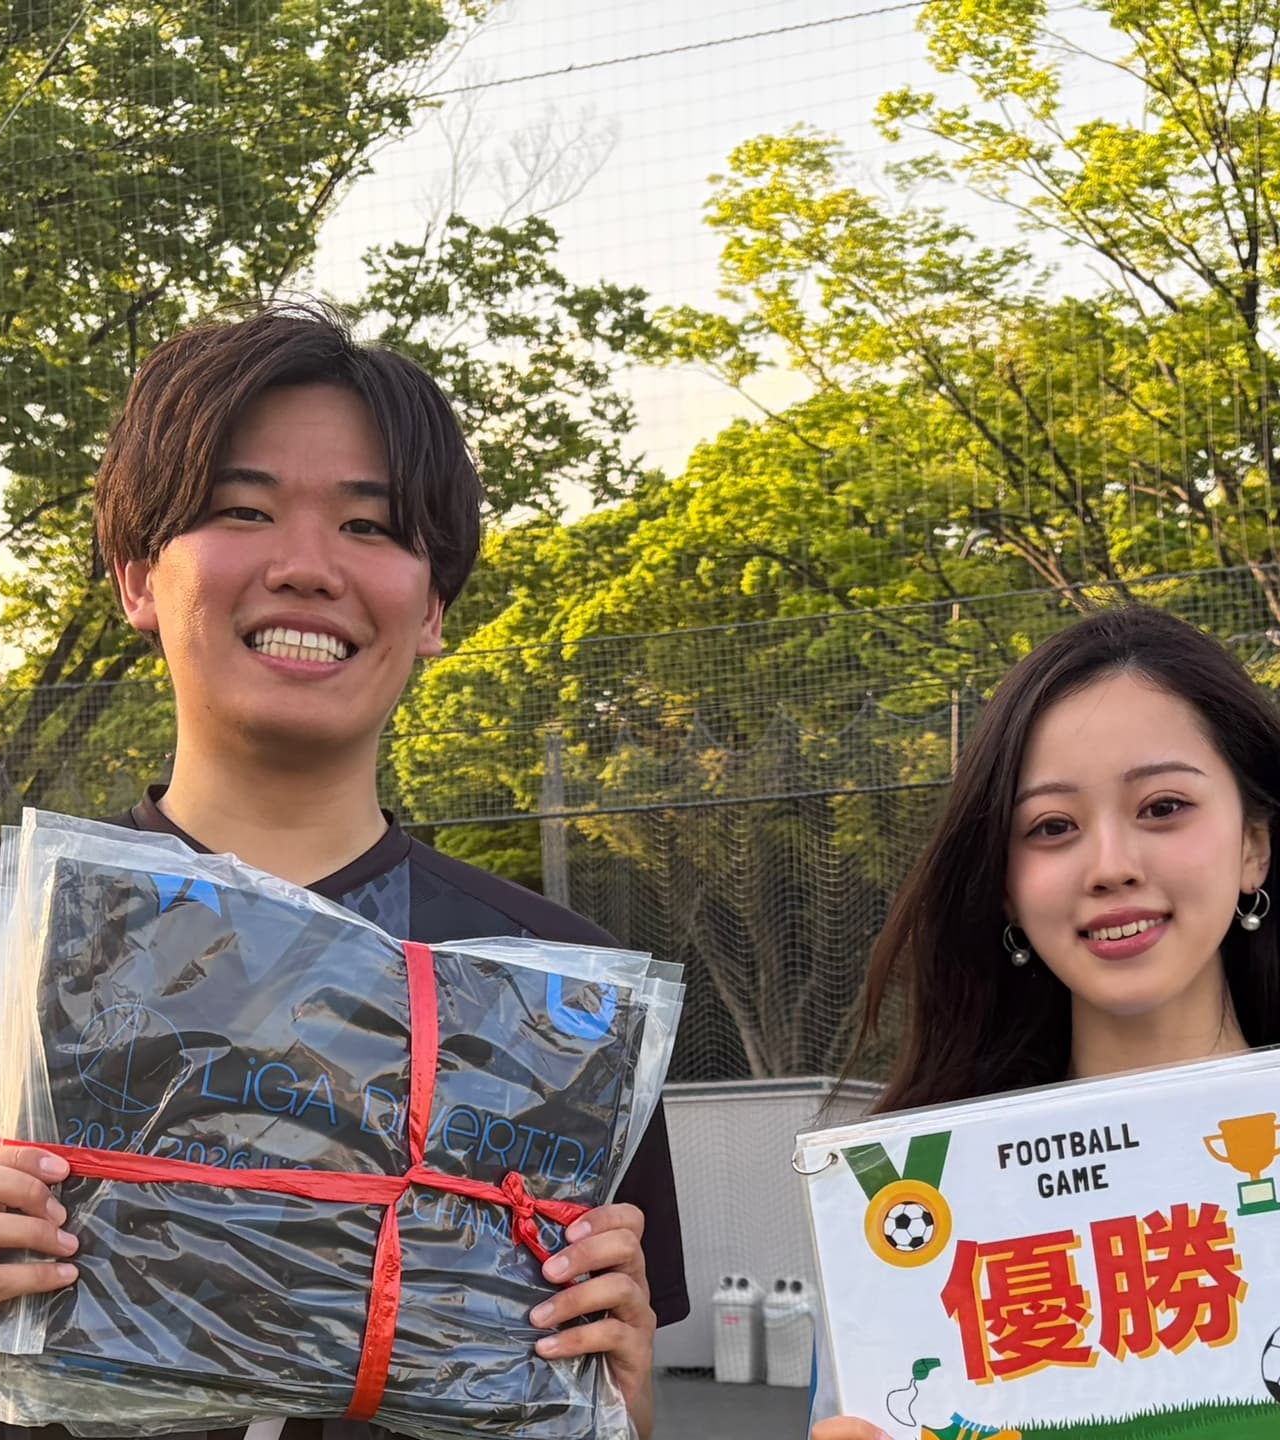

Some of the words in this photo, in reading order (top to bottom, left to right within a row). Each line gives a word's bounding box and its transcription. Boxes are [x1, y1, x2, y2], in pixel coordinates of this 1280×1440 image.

[997, 1122, 1140, 1169] FOOTBALL
[1037, 1163, 1109, 1199] GAME
[940, 1202, 1249, 1386] 優勝
